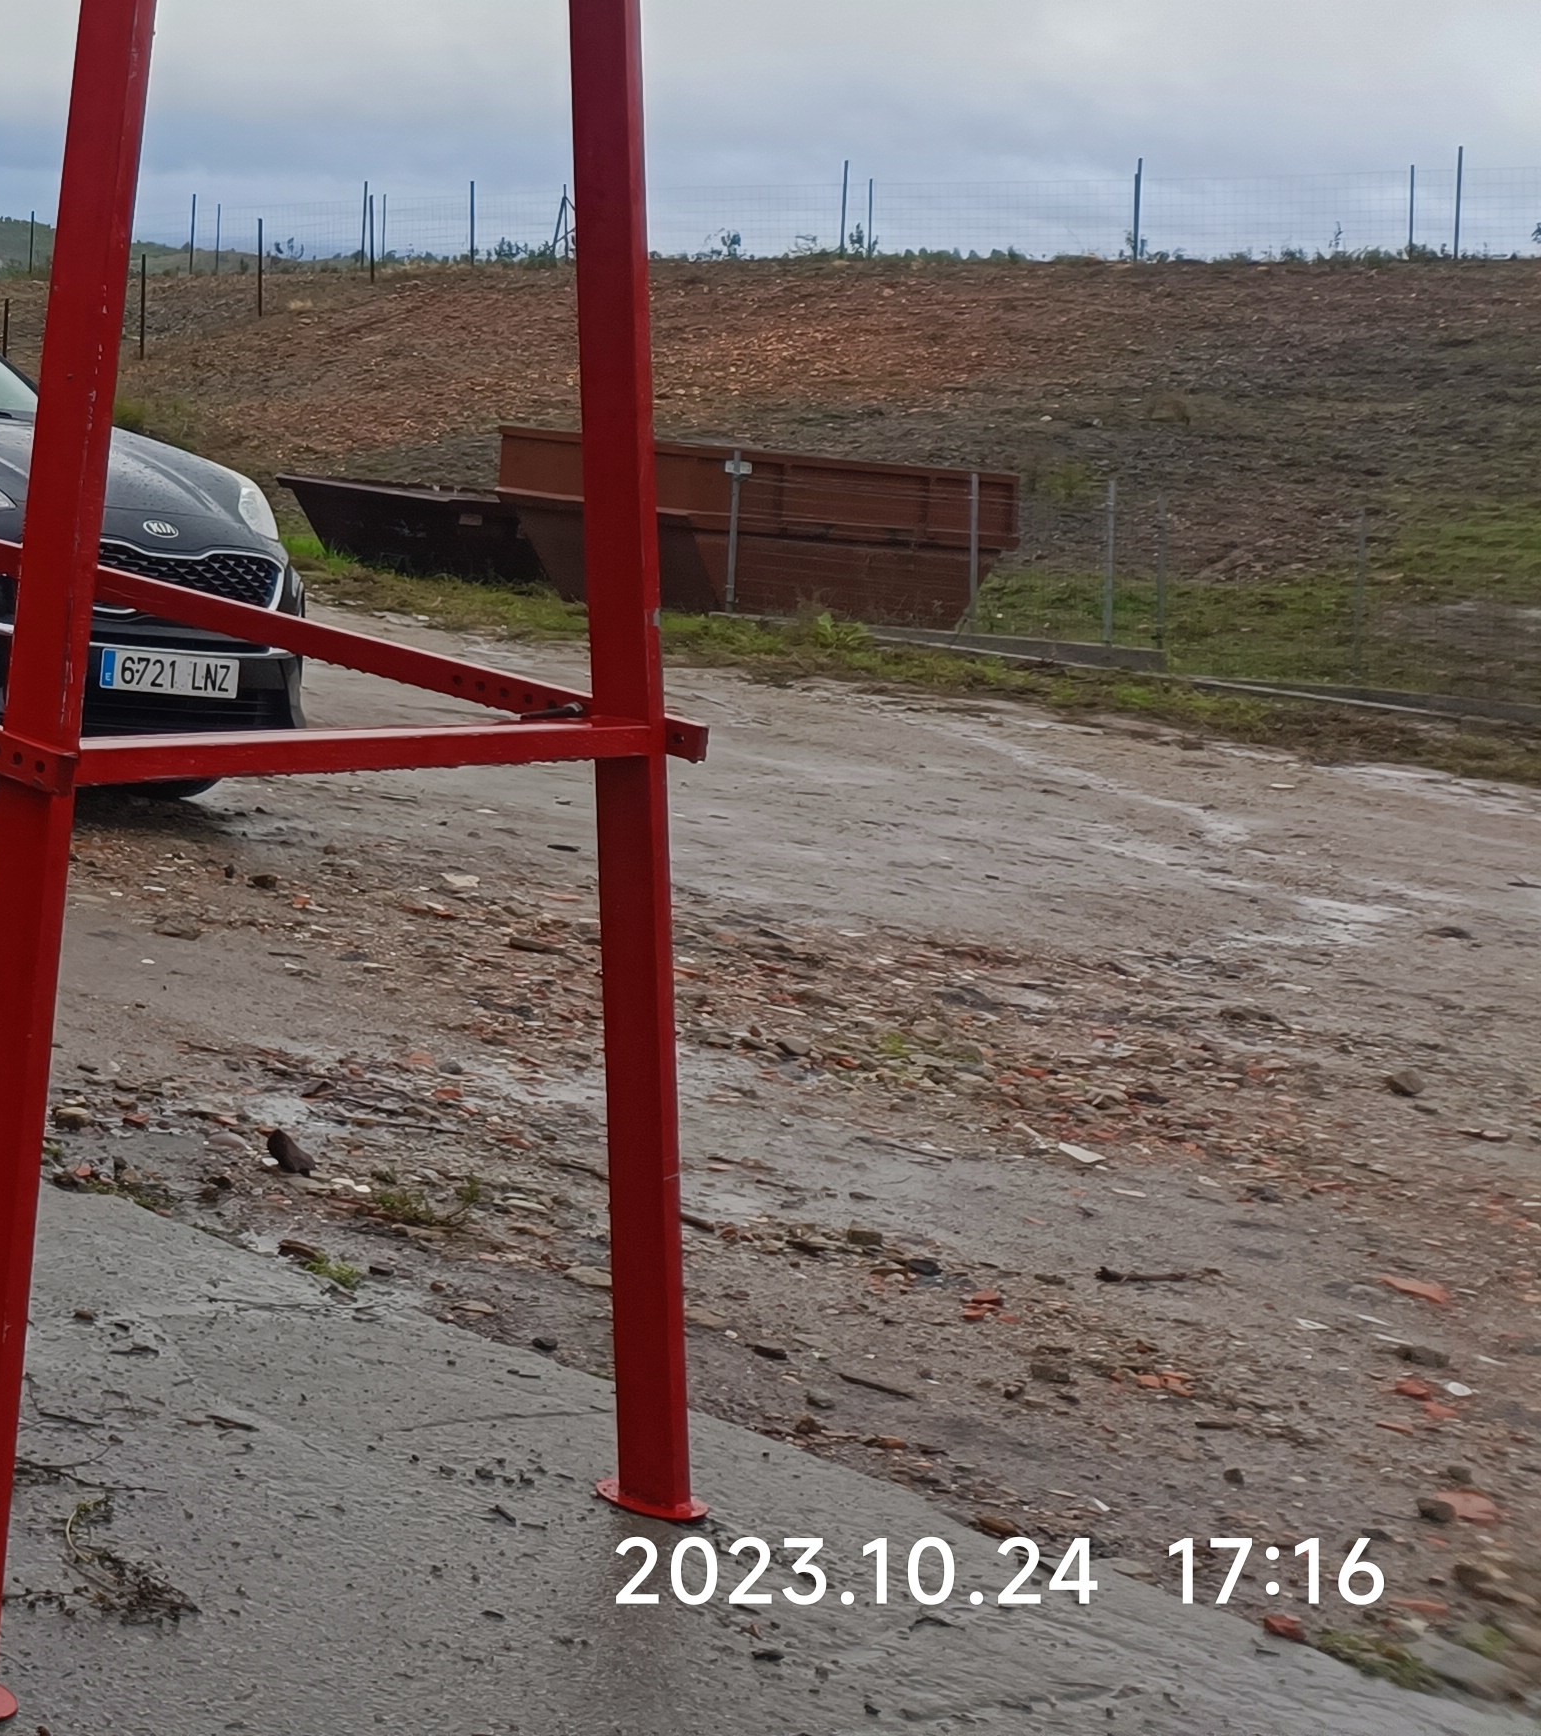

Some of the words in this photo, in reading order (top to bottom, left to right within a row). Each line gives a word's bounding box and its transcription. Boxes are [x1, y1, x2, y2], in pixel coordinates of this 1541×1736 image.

[147, 521, 177, 535] KIA
[104, 672, 112, 681] E
[120, 656, 177, 689] 6721
[191, 662, 231, 693] LNZ
